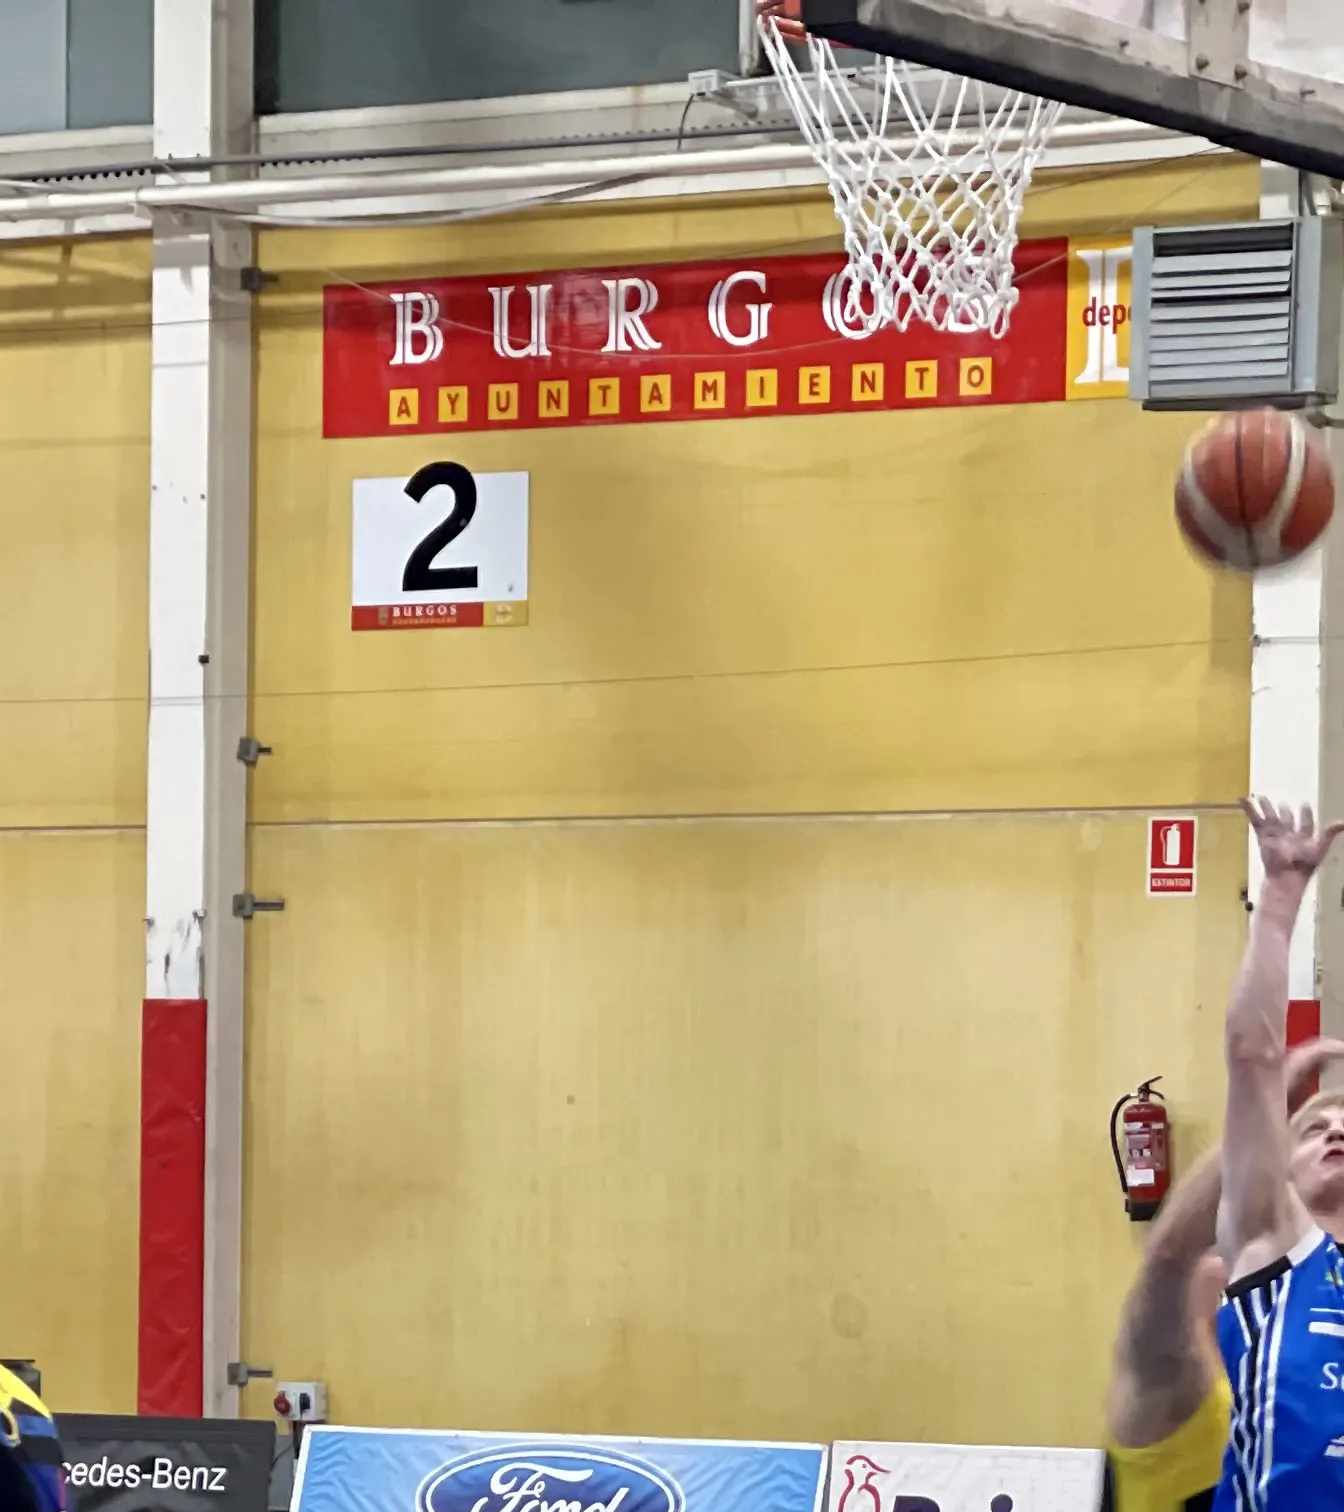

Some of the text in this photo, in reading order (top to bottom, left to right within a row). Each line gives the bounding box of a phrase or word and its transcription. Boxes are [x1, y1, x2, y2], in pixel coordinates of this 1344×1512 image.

[396, 364, 984, 418] AYUNTAMIENTO
[402, 461, 478, 591] 2
[392, 604, 457, 618] BURGOS
